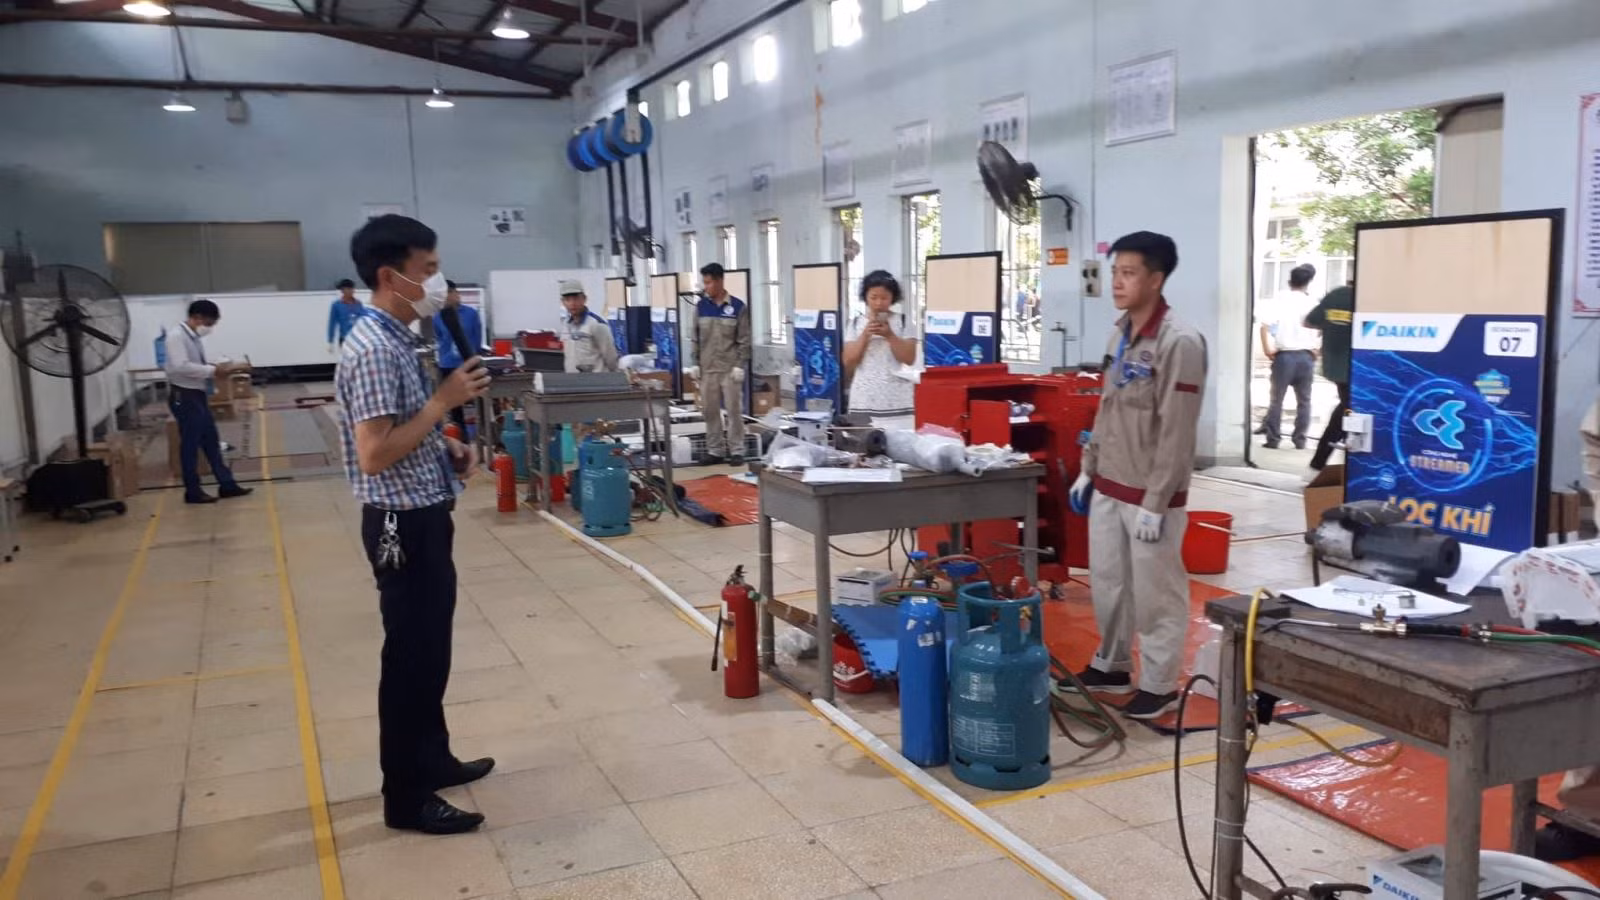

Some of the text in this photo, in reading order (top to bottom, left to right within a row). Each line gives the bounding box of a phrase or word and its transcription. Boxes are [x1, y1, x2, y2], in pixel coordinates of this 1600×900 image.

[1376, 325, 1437, 338] DAIKIN
[1499, 337, 1521, 352] 07
[1442, 502, 1495, 535] KHÍ
